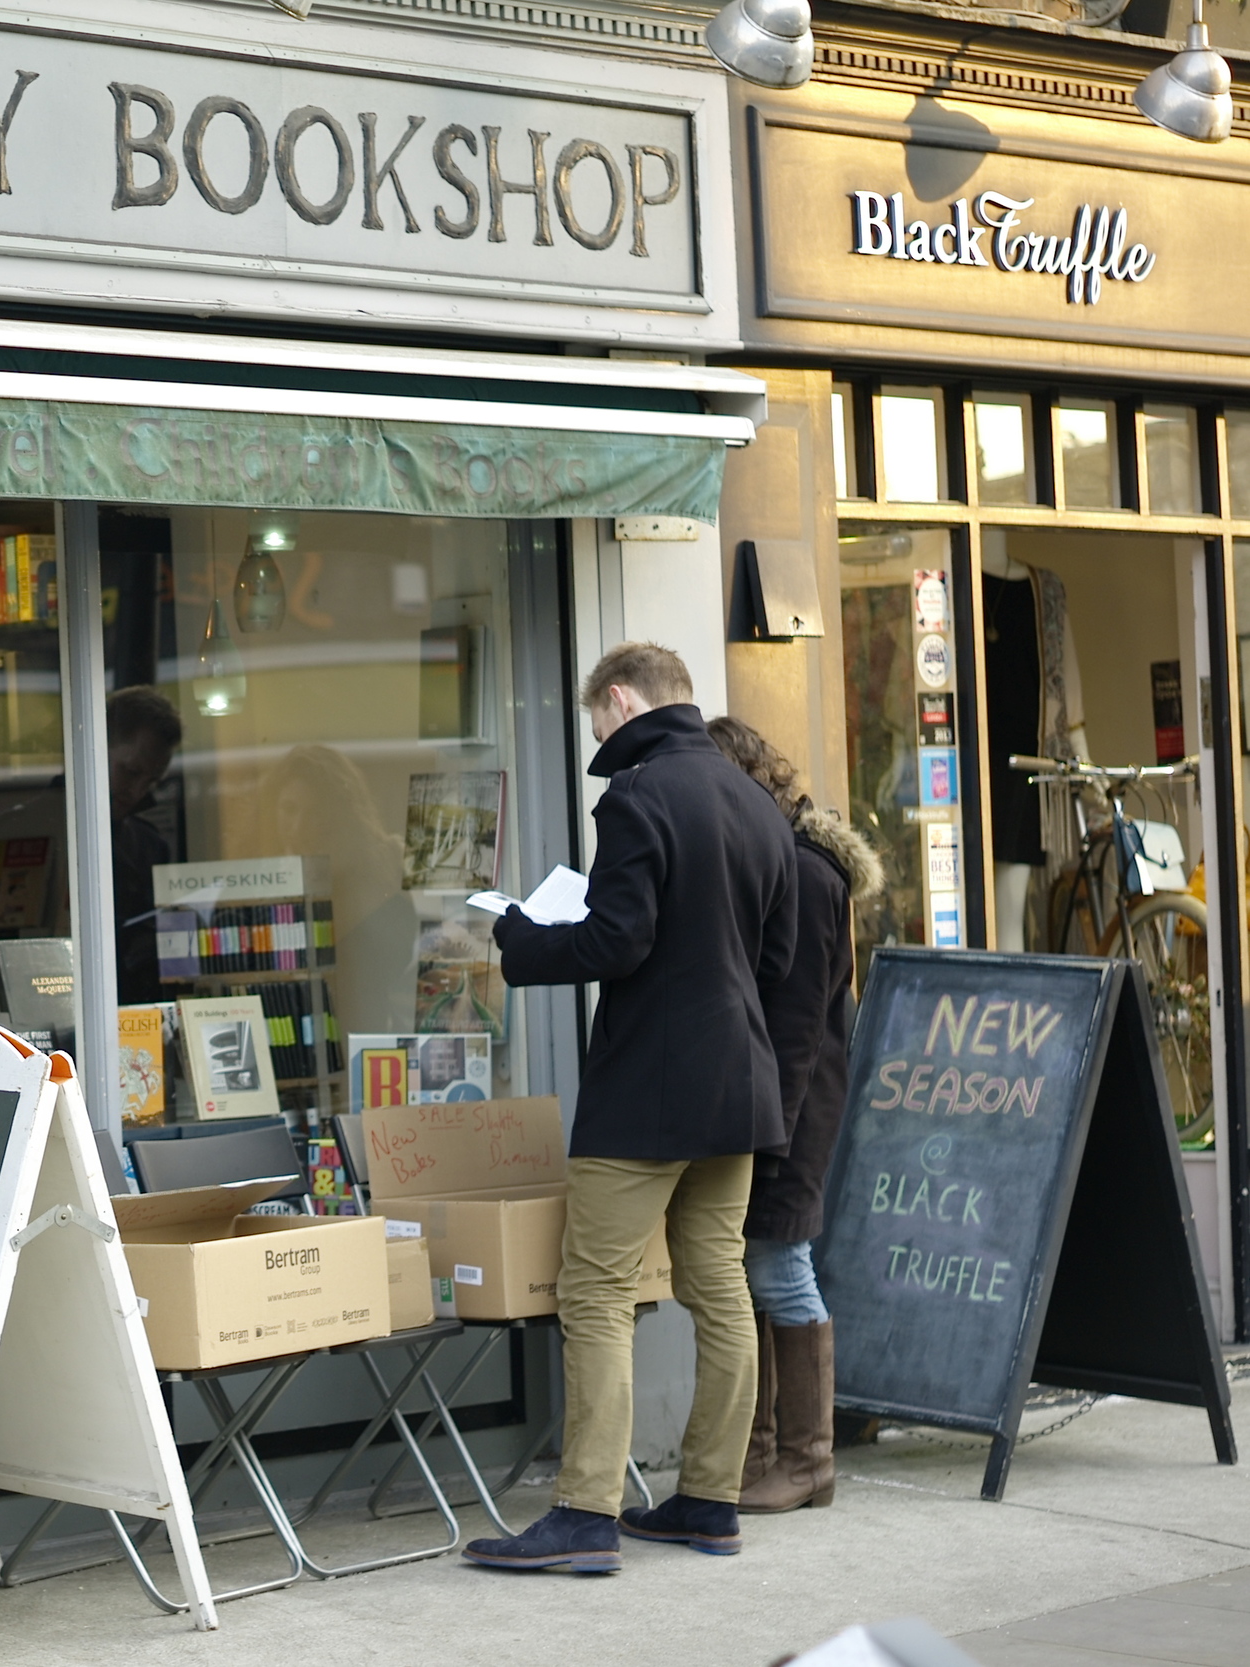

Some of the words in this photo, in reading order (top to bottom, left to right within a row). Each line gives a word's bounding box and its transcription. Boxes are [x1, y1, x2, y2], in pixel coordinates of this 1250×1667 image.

[108, 80, 681, 258] BOOKSHOP
[854, 189, 990, 267] Black
[976, 190, 1156, 305] Truffle
[431, 432, 588, 501] Books
[168, 871, 288, 891] MOLESKINE
[31, 976, 74, 986] ALEXANDER
[36, 985, 73, 995] McQUEEN
[205, 1009, 228, 1017] Buildings
[31, 1030, 51, 1040] FIRST
[924, 994, 1063, 1059] NEW
[871, 1060, 1044, 1118] SEASON
[419, 1107, 465, 1122] SALE
[370, 1120, 417, 1161] New
[391, 1153, 436, 1185] Books
[871, 1173, 983, 1225] BLACK
[265, 1247, 320, 1270] Bertram
[300, 1264, 321, 1276] Group
[888, 1246, 1011, 1302] TRUFFLE
[267, 1286, 322, 1303] www.bertrams.com
[342, 1308, 370, 1321] Bertram
[219, 1329, 249, 1343] Bertram
